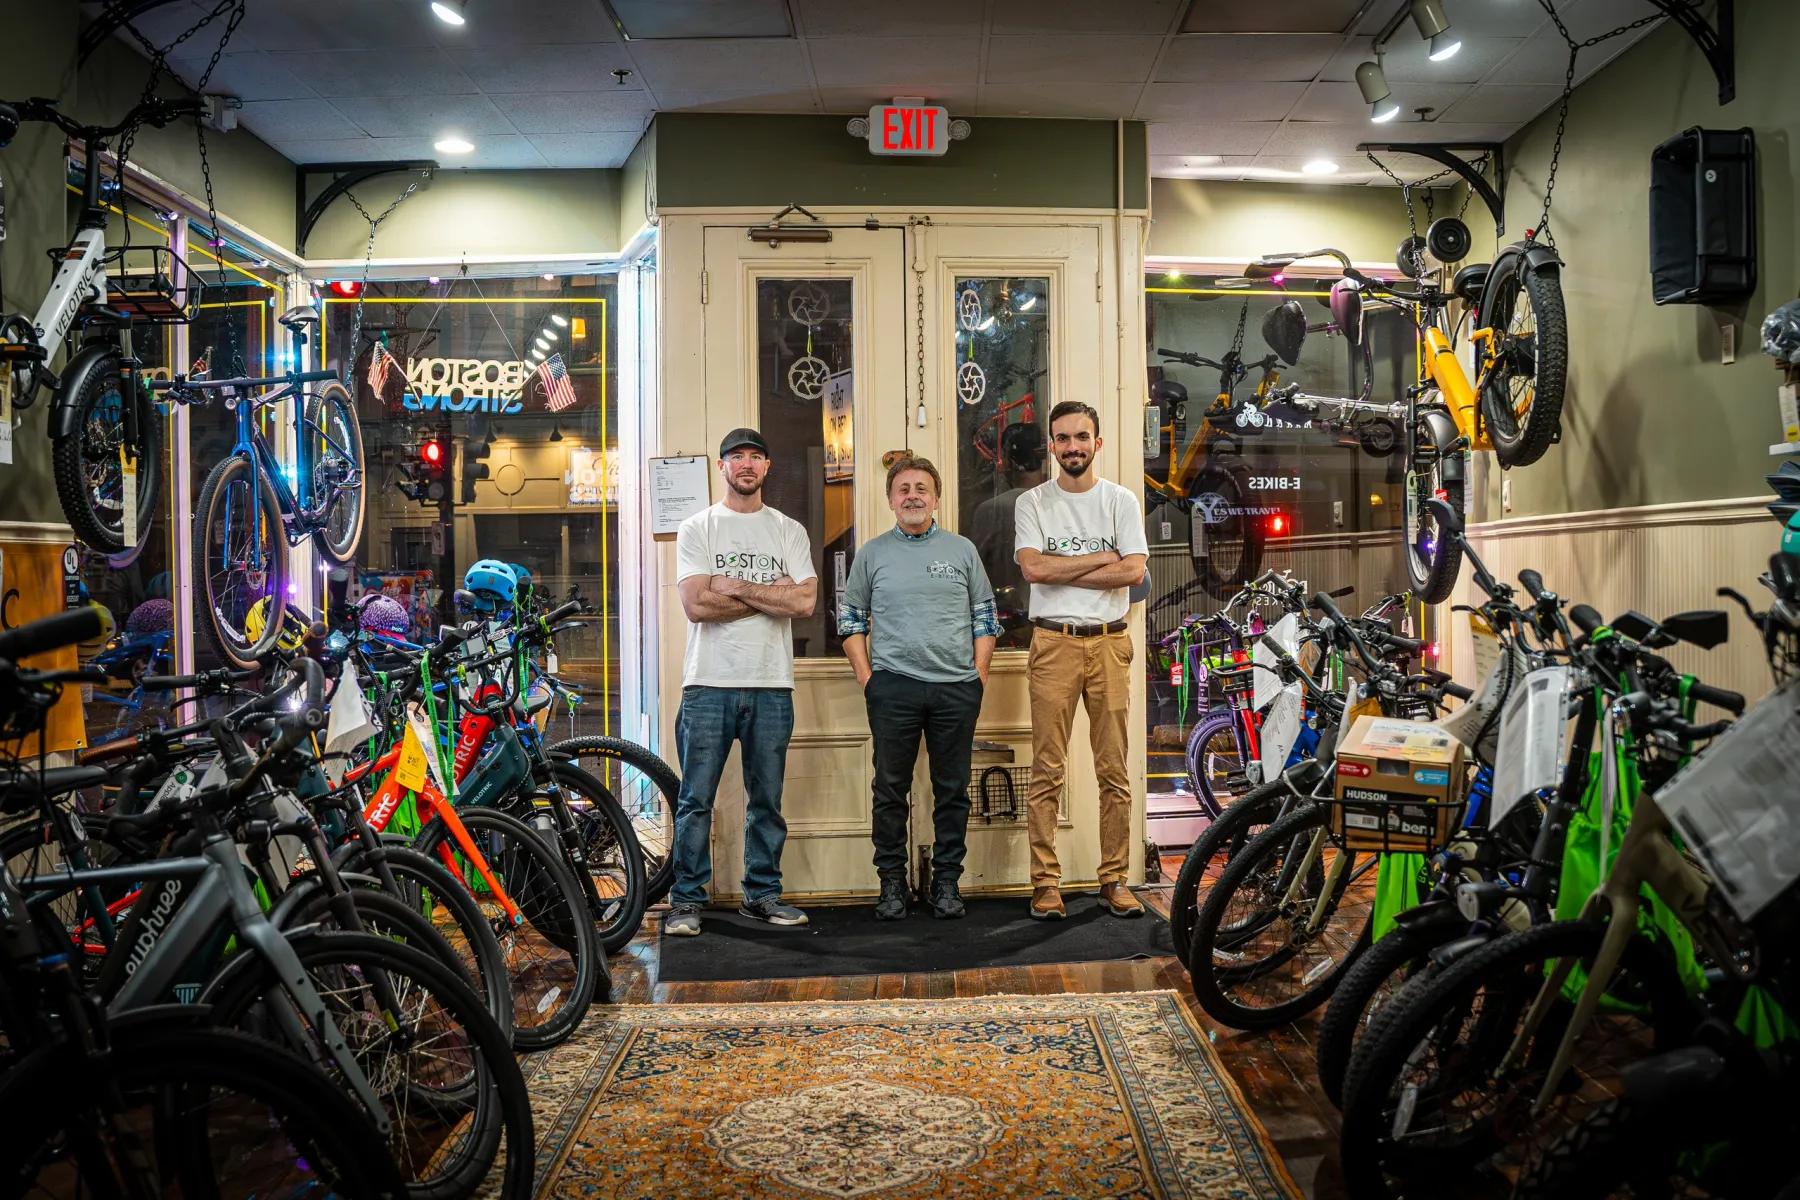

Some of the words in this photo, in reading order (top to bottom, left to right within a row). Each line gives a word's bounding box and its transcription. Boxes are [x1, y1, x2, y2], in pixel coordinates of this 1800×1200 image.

[883, 107, 939, 151] EXIT
[55, 266, 92, 338] VELOTRIC
[1227, 507, 1242, 516] WE
[1047, 535, 1115, 554] BOSTON
[715, 551, 784, 572] BOSTON
[724, 570, 777, 583] E-BIKES
[926, 564, 962, 577] BOSTON
[930, 573, 959, 581] E-BIKES
[579, 747, 621, 756] KENDA
[470, 781, 493, 805] VELOTRIC
[1346, 789, 1388, 802] HUDSON
[125, 879, 182, 975] euphree
